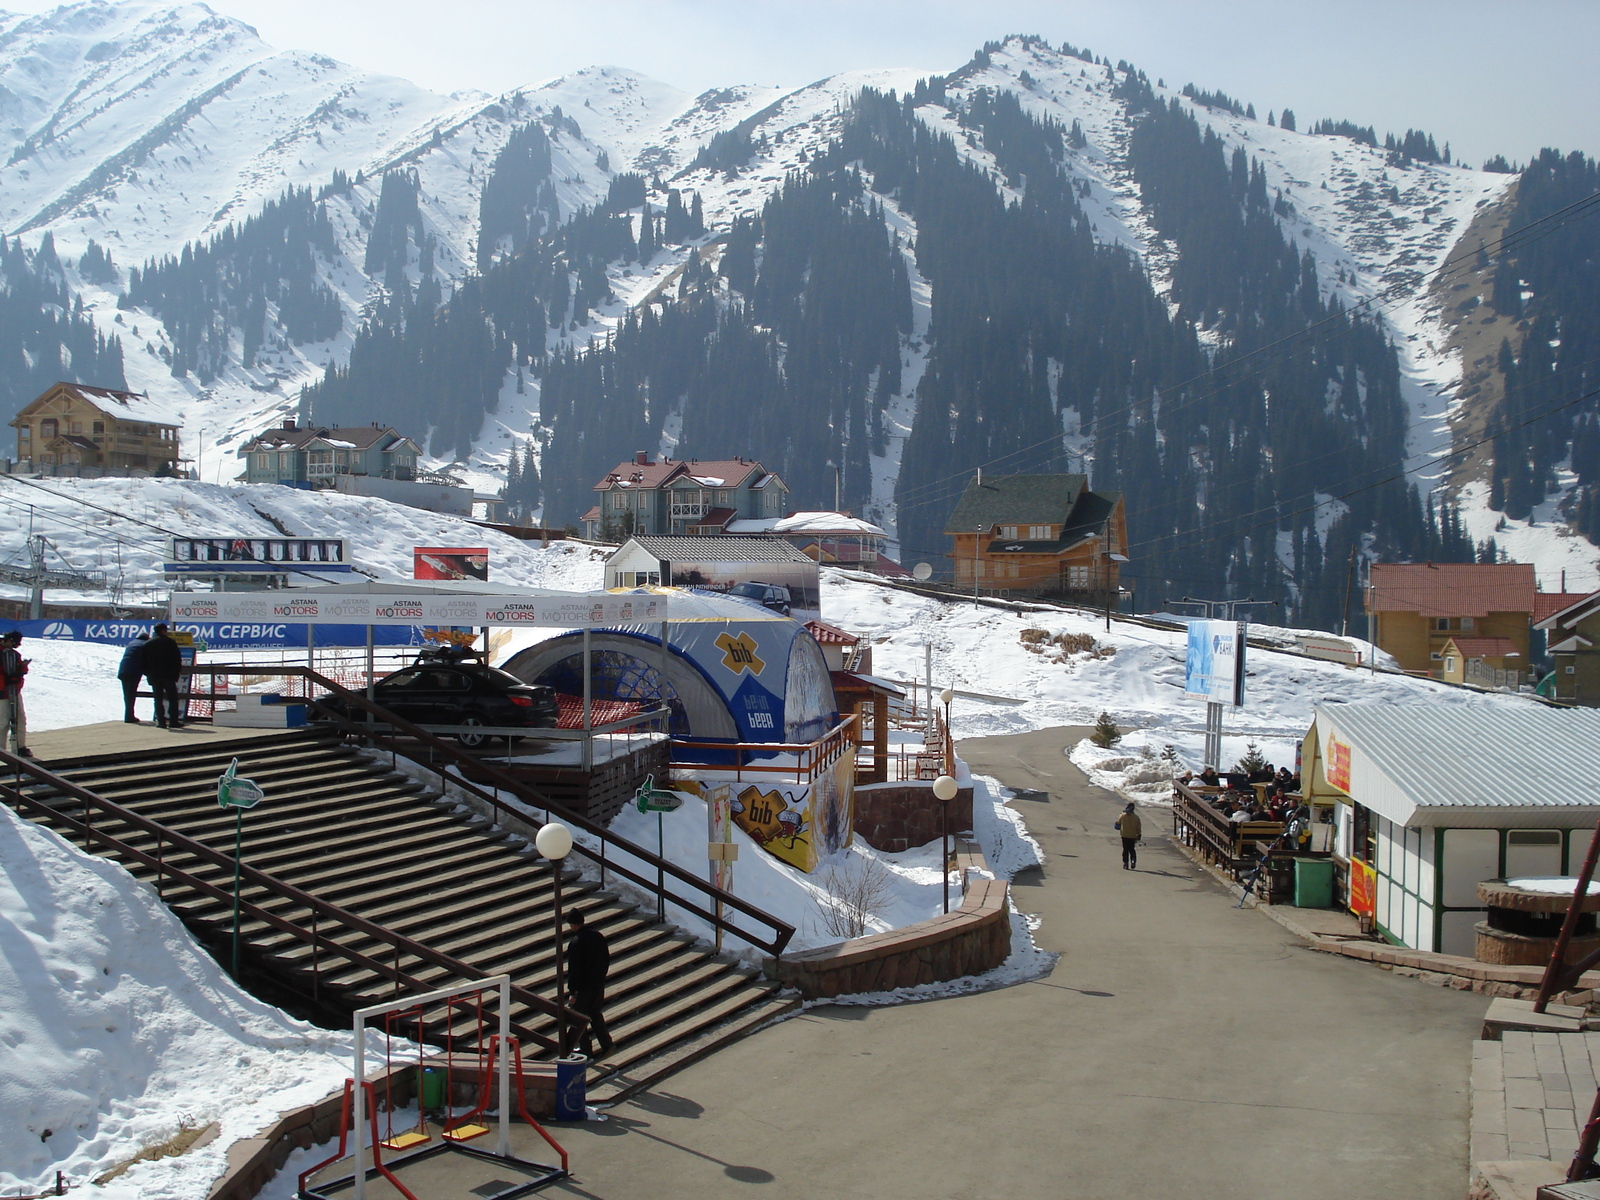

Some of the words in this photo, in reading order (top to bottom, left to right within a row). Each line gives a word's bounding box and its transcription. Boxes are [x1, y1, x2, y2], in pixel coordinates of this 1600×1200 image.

[176, 608, 218, 617] MOTORS
[274, 607, 318, 616] MOTORS
[376, 608, 423, 618] MOTORS
[486, 611, 535, 621] MOTORS
[219, 625, 287, 639] СЕРВИС
[728, 643, 753, 663] bib
[749, 799, 773, 825] bib
